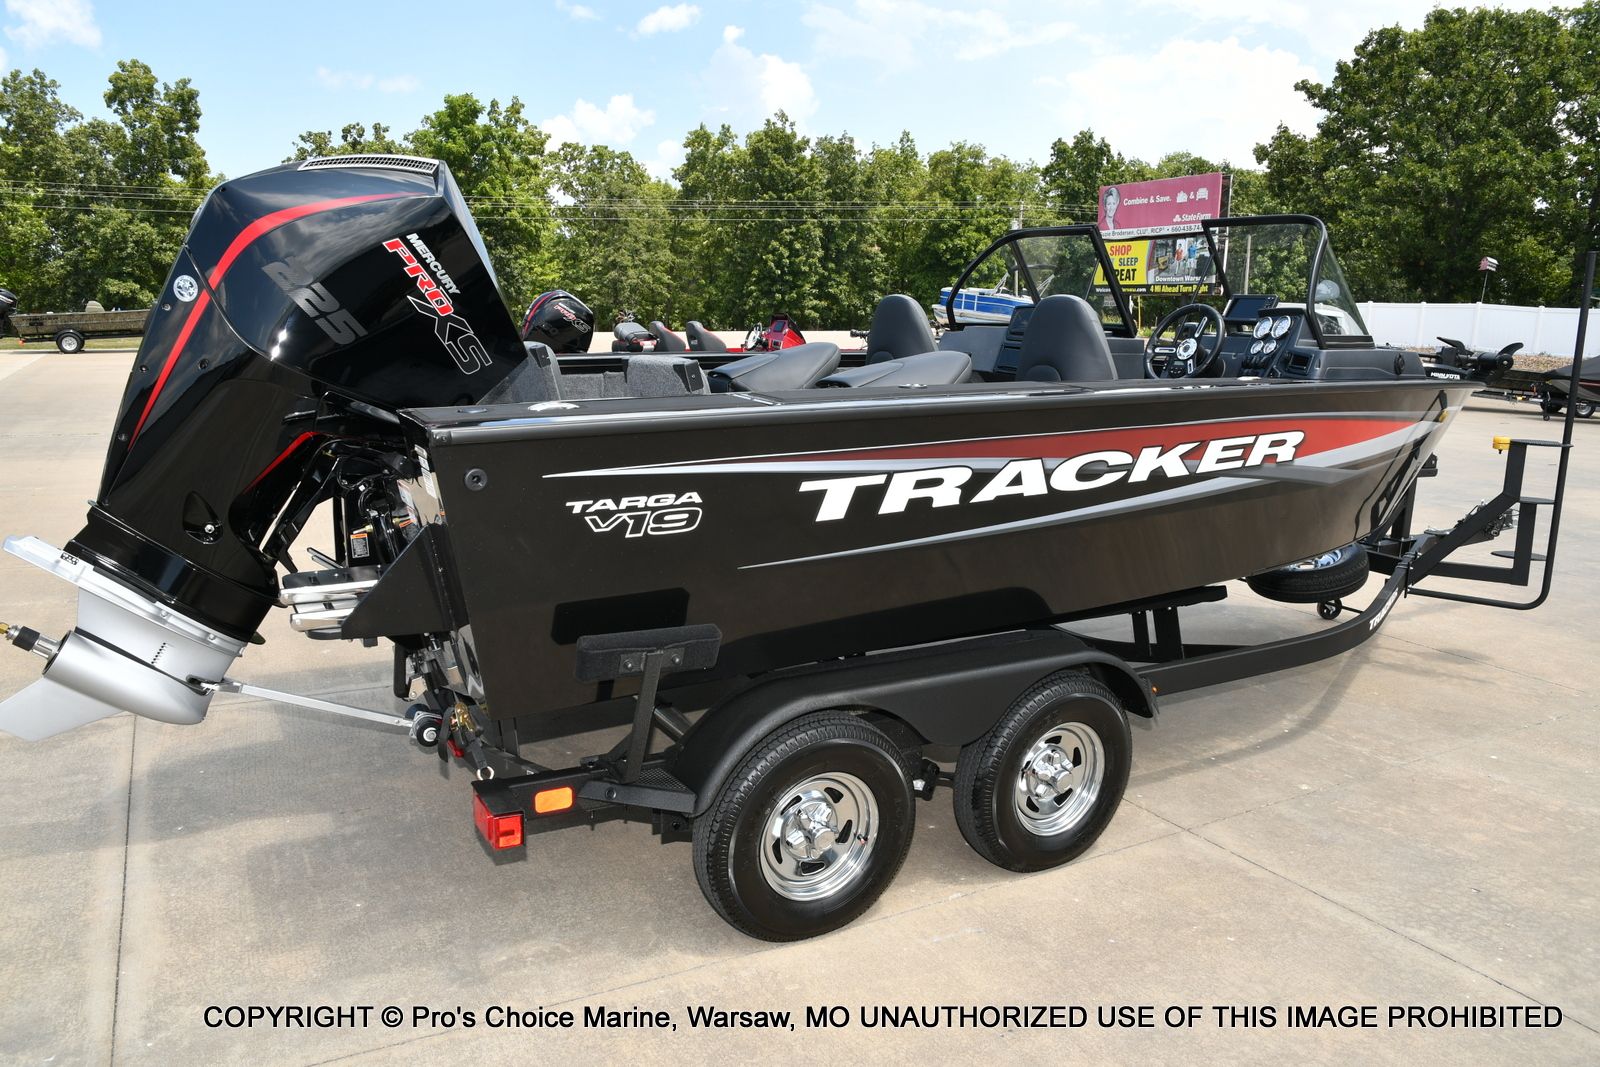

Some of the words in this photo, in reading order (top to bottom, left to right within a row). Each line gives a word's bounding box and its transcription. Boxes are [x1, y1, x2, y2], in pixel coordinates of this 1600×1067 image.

[1123, 196, 1148, 206] Combine
[1149, 195, 1155, 203] &
[1156, 195, 1172, 203] Save.
[1189, 191, 1195, 200] &
[1109, 244, 1132, 257] SHOP
[1118, 257, 1138, 267] SLEEP
[406, 233, 461, 295] MERCURY
[382, 237, 455, 317] PRO
[1150, 284, 1154, 293] 4
[1161, 284, 1179, 293] Ahead
[1179, 284, 1193, 293] Turn
[1192, 284, 1209, 293] Rght
[1155, 275, 1184, 283] Downtown
[261, 255, 369, 345] 225
[406, 294, 493, 375] XS
[799, 430, 1306, 523] TRACKER
[565, 491, 703, 514] TARGA
[584, 507, 703, 539] V19
